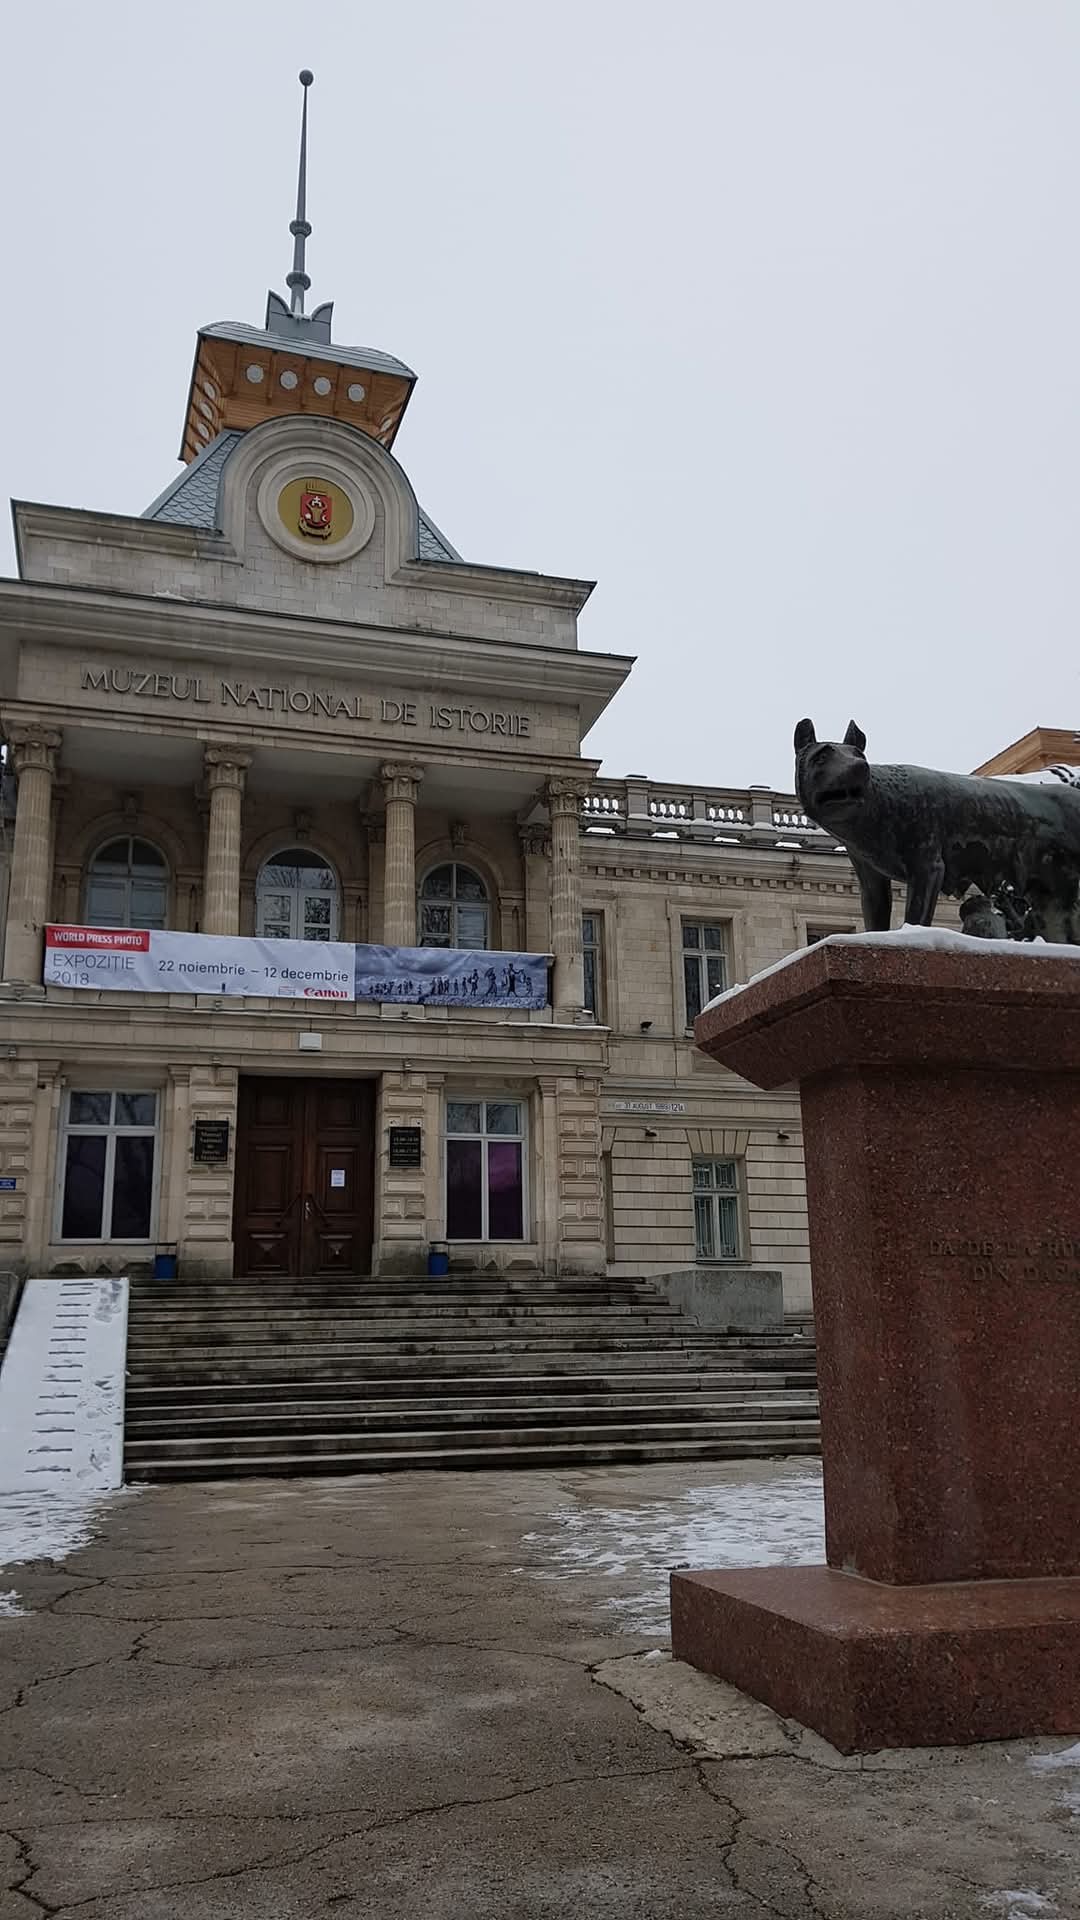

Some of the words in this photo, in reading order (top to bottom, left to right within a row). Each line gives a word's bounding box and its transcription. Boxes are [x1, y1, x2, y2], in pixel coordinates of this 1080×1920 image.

[81, 669, 211, 703] MUZEUL
[381, 700, 417, 726] DE
[430, 706, 530, 738] ISTORIE
[54, 931, 85, 943] WORLD
[86, 933, 113, 945] PRESS
[114, 935, 142, 946] PHOTO
[52, 970, 89, 986] 2018
[159, 960, 174, 972] 22
[178, 961, 246, 976] noiembrie
[264, 967, 277, 978] 12
[281, 967, 349, 982] decembrie
[303, 987, 348, 999] Canon
